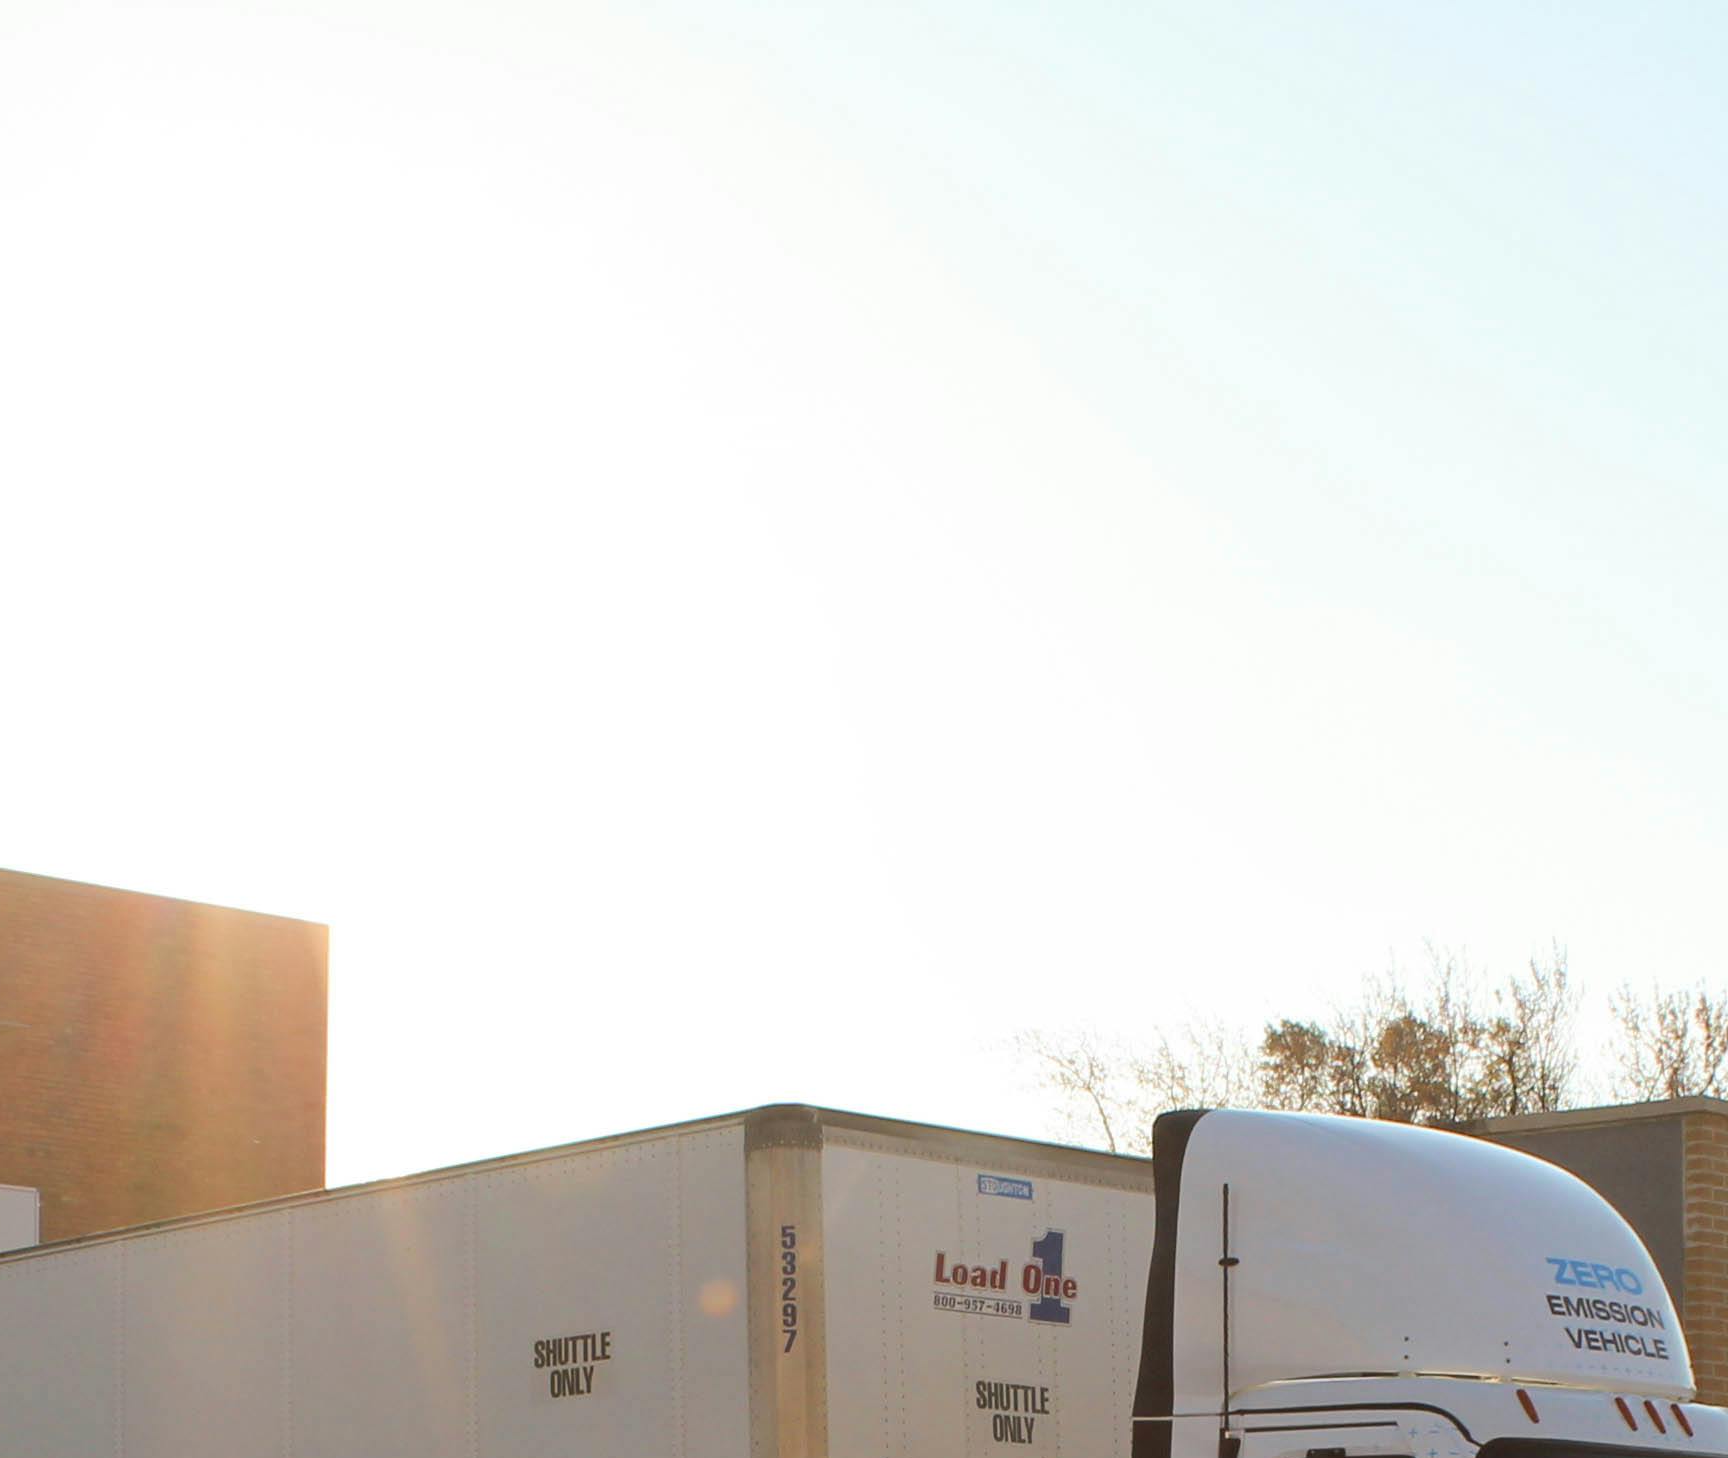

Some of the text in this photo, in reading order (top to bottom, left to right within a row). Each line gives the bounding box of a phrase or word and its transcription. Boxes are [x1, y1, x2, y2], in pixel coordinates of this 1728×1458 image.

[781, 1225, 798, 1353] 53297
[934, 1252, 1079, 1300] Load One
[1546, 1257, 1643, 1296] ZERO
[933, 1295, 1022, 1316] 800-957-4698
[1546, 1294, 1666, 1330] EMISSION
[534, 1331, 611, 1369] SHUTTLE
[1565, 1327, 1669, 1360] VEHICLE
[550, 1365, 594, 1398] ONLY
[975, 1380, 1050, 1415] SHUTTLE
[992, 1414, 1035, 1444] ONLY
